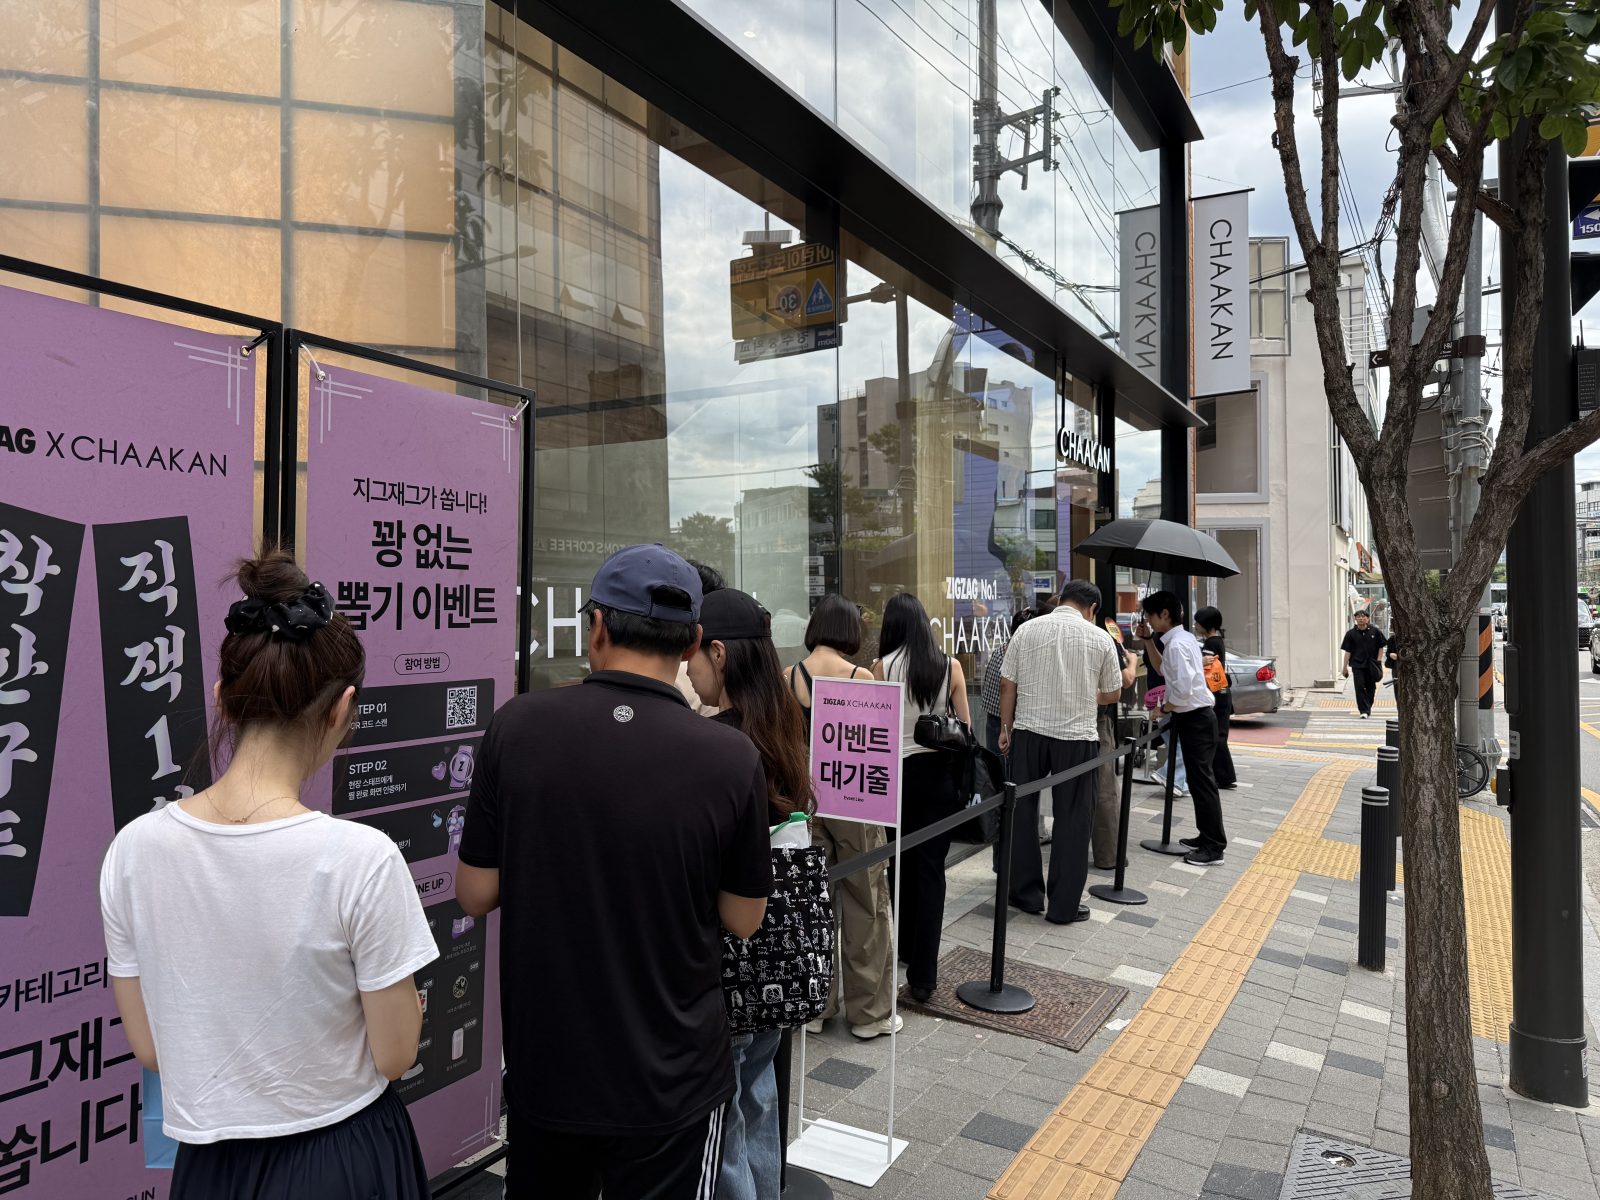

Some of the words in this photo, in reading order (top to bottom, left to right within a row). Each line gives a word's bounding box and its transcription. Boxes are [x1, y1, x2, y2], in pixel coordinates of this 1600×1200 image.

[1209, 219, 1234, 361] CHAAKAN
[71, 436, 227, 477] CHAAKAN
[1060, 427, 1110, 475] CHAAKAN
[353, 477, 437, 509] 지그재그가
[440, 487, 487, 514] 쏩니다!
[372, 520, 406, 568] 꽝
[413, 523, 472, 570] 없는
[946, 576, 978, 600] ZIGZAG
[981, 579, 997, 600] No.1
[335, 581, 403, 630] 뽑기
[412, 583, 497, 630] 이벤트
[404, 657, 422, 670] 참여
[423, 656, 440, 669] 방법
[355, 704, 375, 715] TEP
[377, 702, 387, 713] 01
[823, 698, 845, 706] ZIGZAG
[361, 720, 374, 729] 코드
[822, 721, 891, 753] 이벤트
[349, 762, 374, 775] STEP
[375, 760, 387, 771] 02
[820, 760, 890, 796] 대기줄
[432, 878, 444, 890] UP
